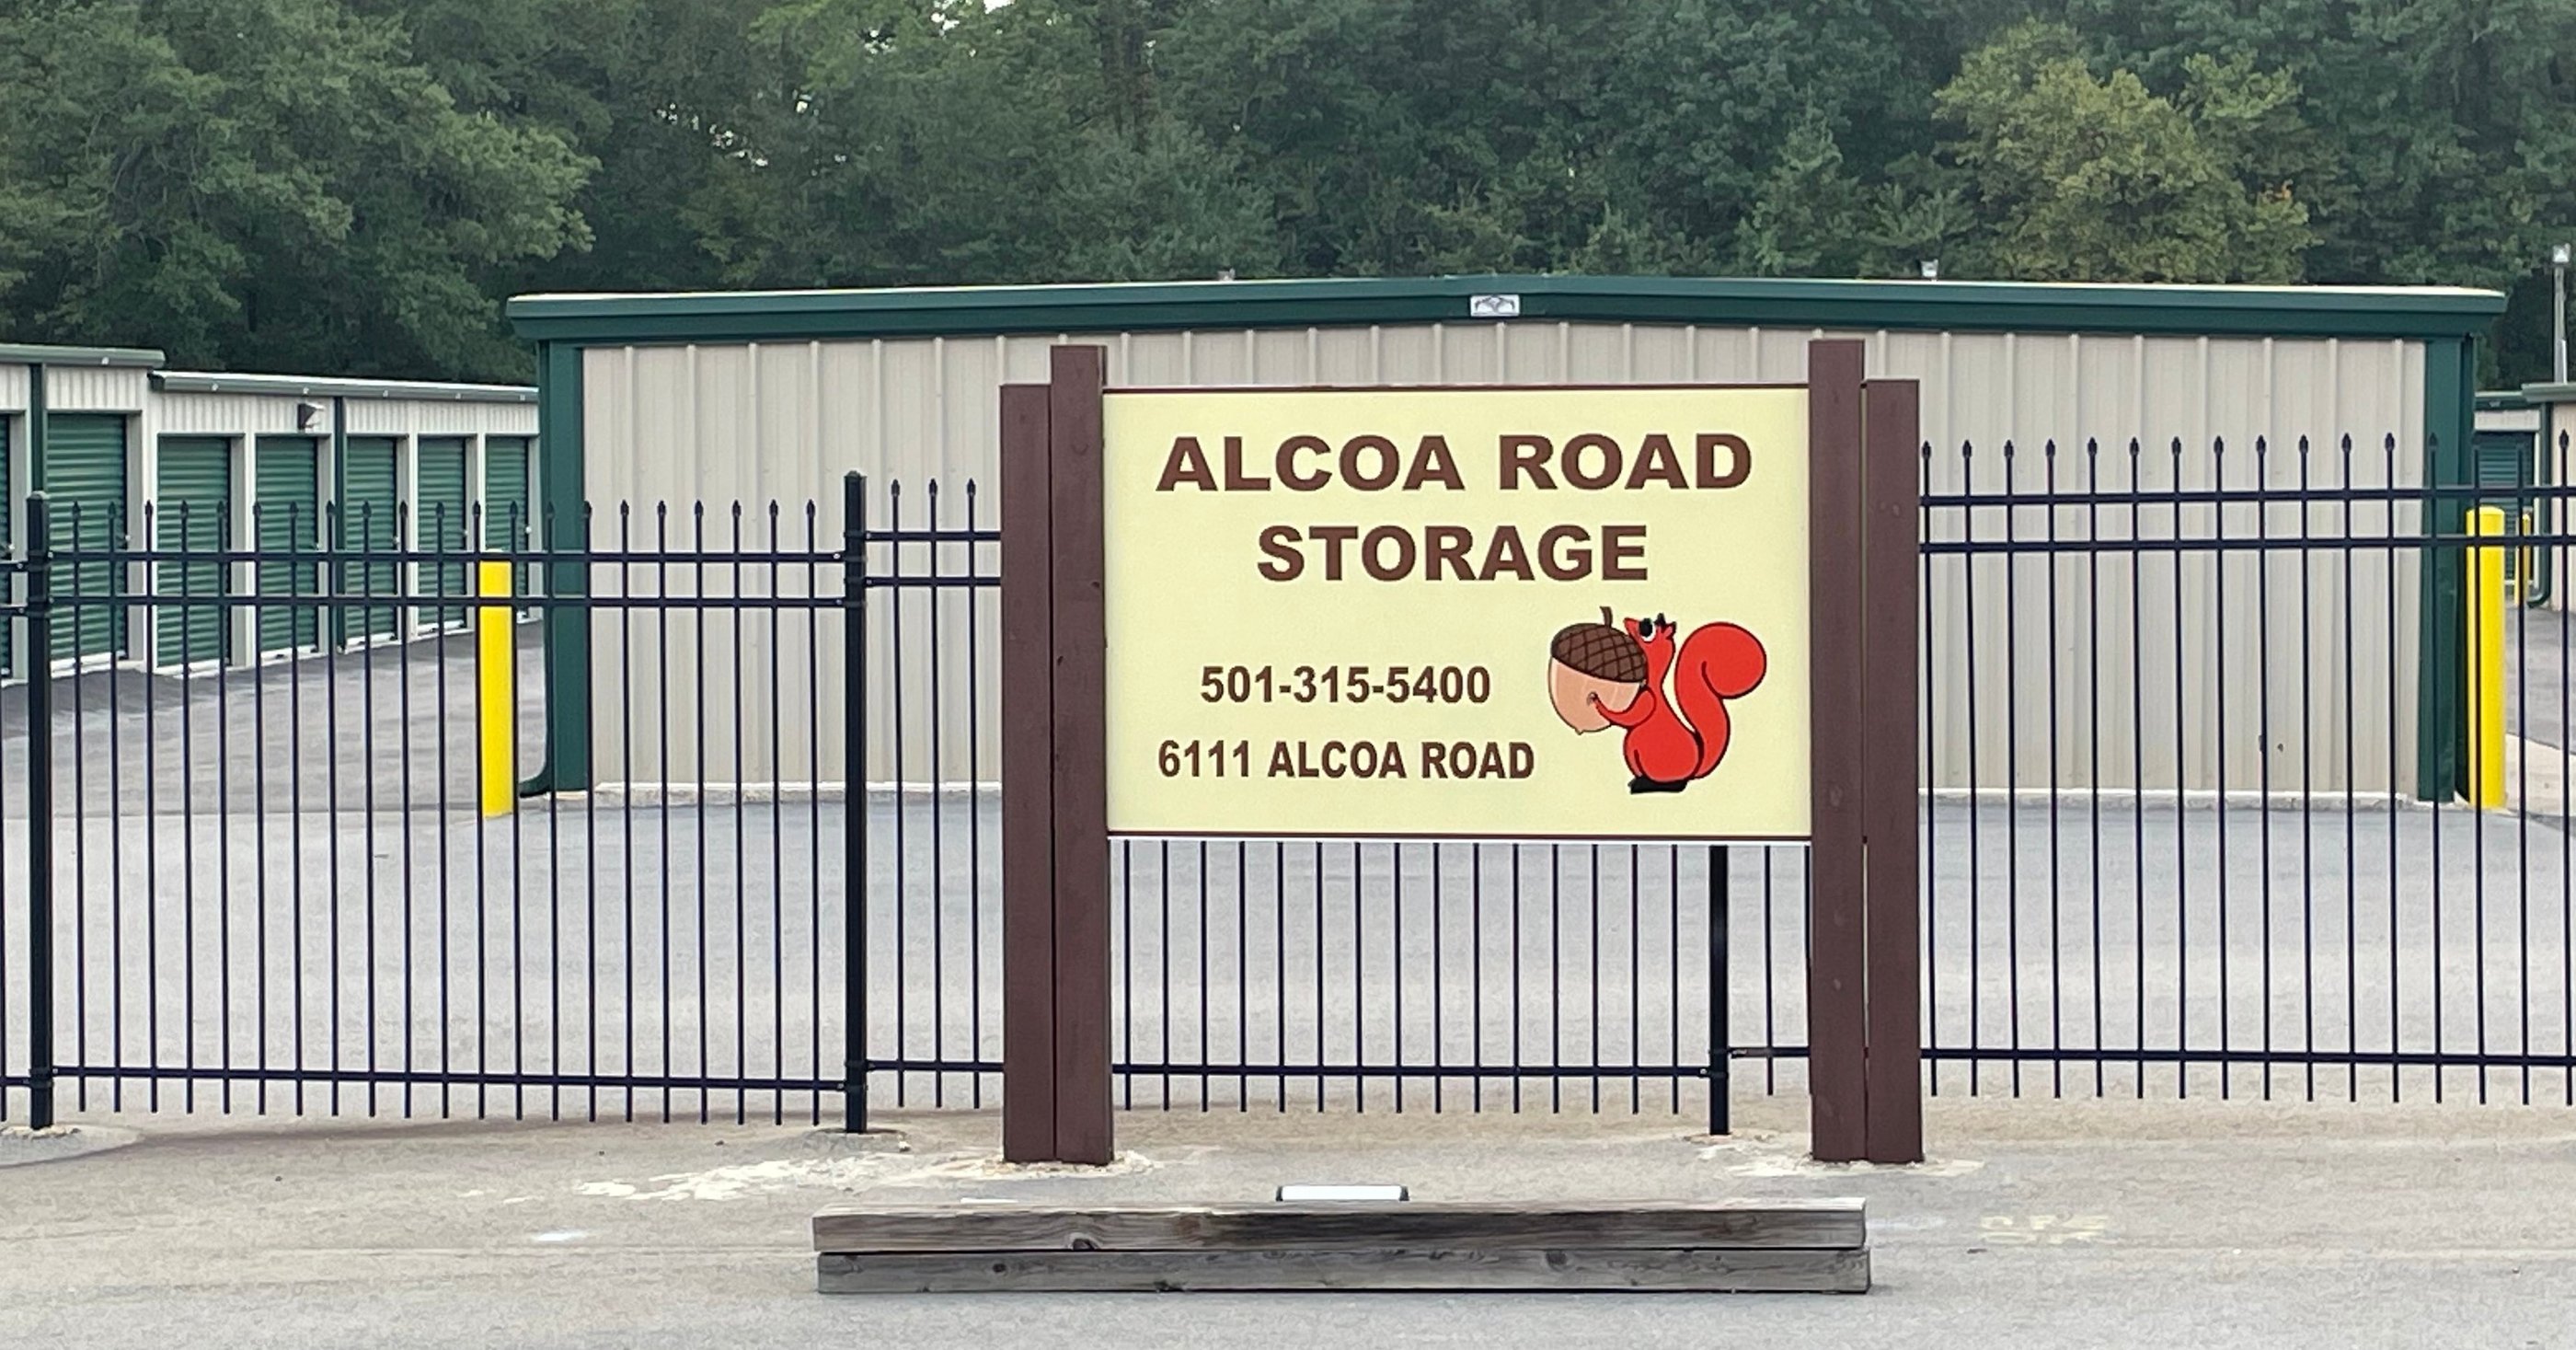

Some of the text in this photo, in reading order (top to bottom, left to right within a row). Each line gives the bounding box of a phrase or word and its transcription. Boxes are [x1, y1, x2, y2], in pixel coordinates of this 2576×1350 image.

[1156, 433, 1752, 492] ALCOA ROAD
[1257, 525, 1648, 583] STORAGE
[1201, 665, 1490, 704] 501-315-5400
[1158, 739, 1535, 779] 6111 ALCOA ROAD
